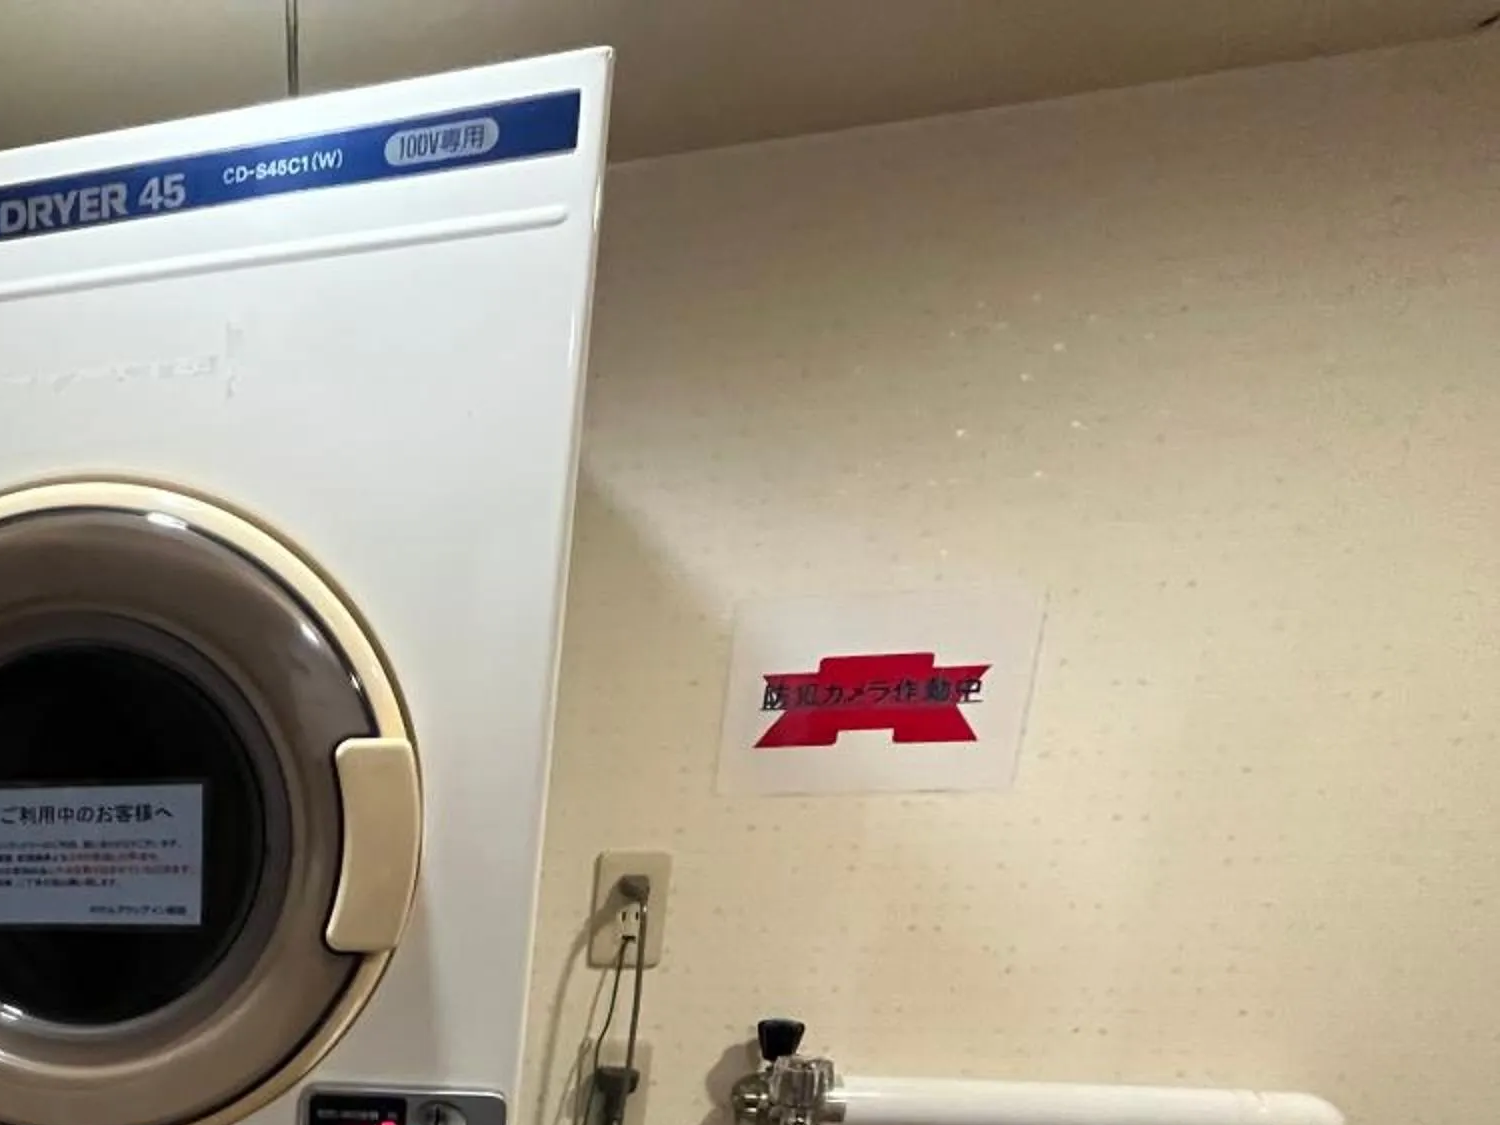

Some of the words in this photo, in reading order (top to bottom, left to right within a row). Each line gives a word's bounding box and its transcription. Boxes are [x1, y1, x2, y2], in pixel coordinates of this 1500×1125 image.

[0, 183, 129, 233] DRYER
[138, 173, 186, 211] 45
[1, 803, 174, 827] ご利用中のお客様へ
